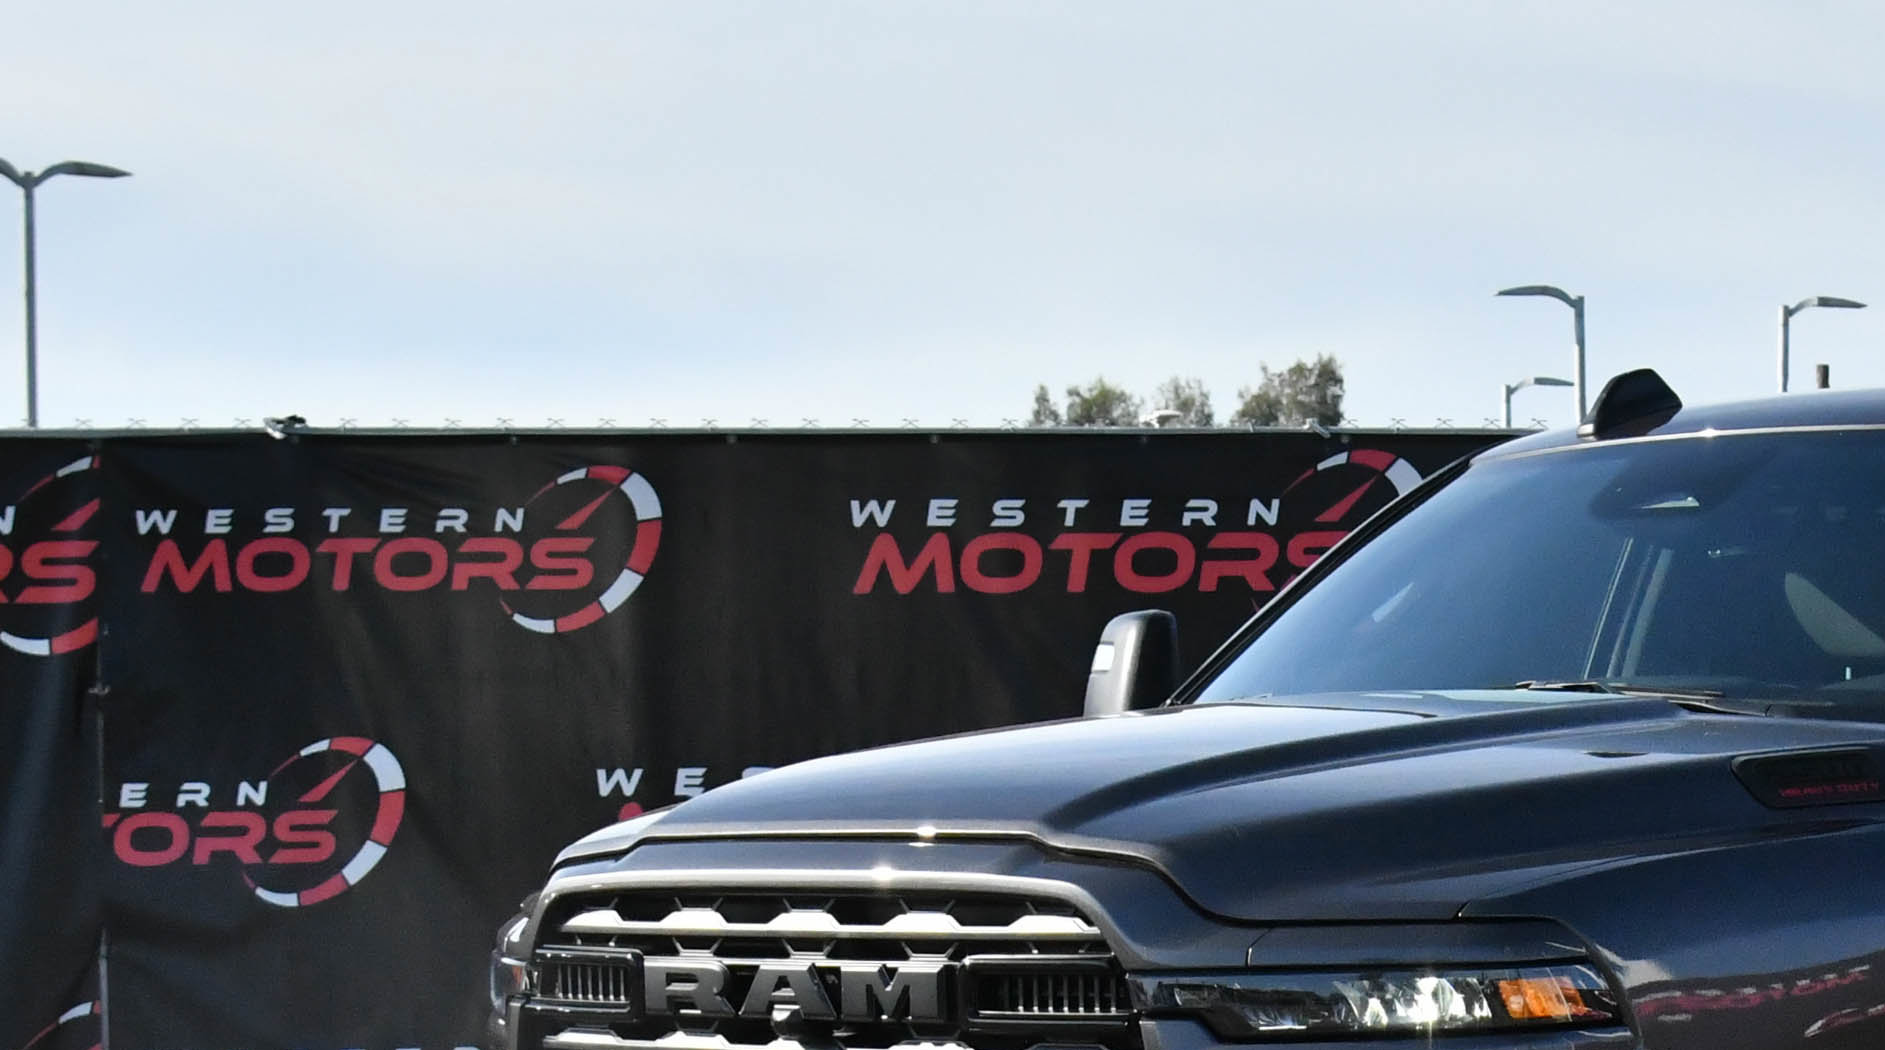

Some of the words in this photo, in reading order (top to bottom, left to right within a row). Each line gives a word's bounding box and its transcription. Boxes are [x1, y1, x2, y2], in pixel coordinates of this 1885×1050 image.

[135, 507, 525, 535] WESTERN
[850, 498, 1281, 528] WESTERN
[140, 536, 595, 593] MOTORS
[644, 957, 950, 1020] RAM
